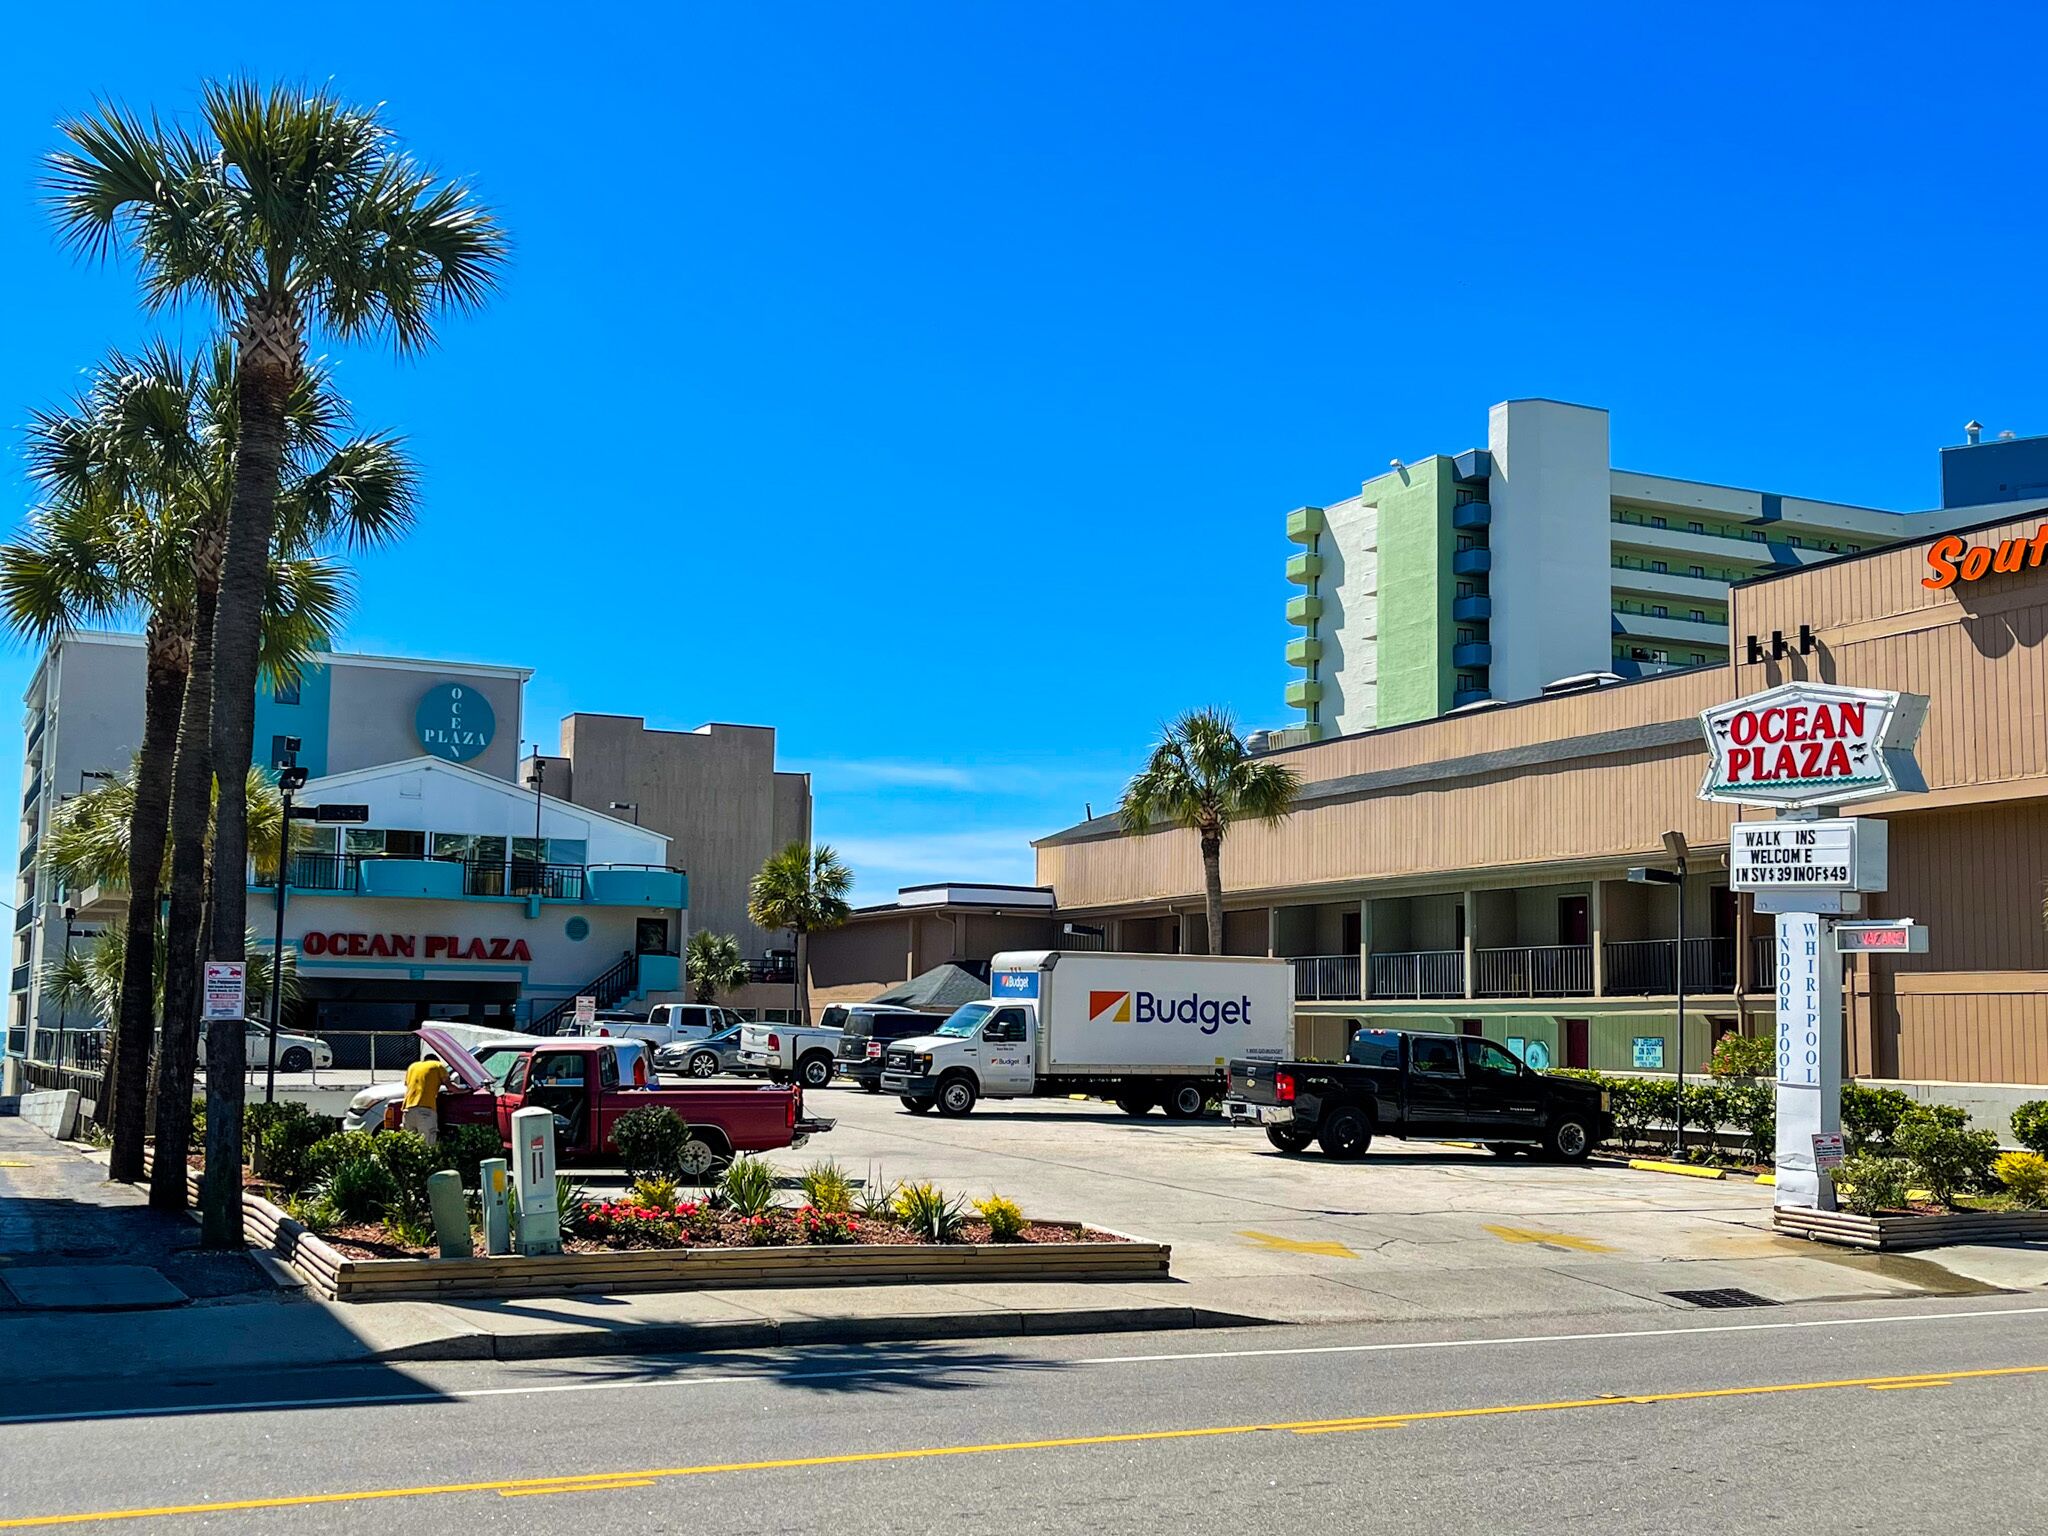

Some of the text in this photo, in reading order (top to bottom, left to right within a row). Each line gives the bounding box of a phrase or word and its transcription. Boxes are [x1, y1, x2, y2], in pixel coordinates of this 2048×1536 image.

[424, 729, 487, 746] PLAZA
[450, 687, 462, 758] OCEAN
[1730, 702, 1867, 746] OCEAN
[1727, 740, 1853, 782] PLAZA
[1745, 829, 1816, 847] WALK INS
[303, 931, 532, 961] OCEAN PLAZA
[1008, 975, 1029, 991] Budget
[1779, 923, 1791, 1082] INDOOR POOL
[1803, 923, 1817, 1083] WHIRLPOOL
[1136, 991, 1251, 1034] Budget
[999, 1058, 1019, 1066] Budget
